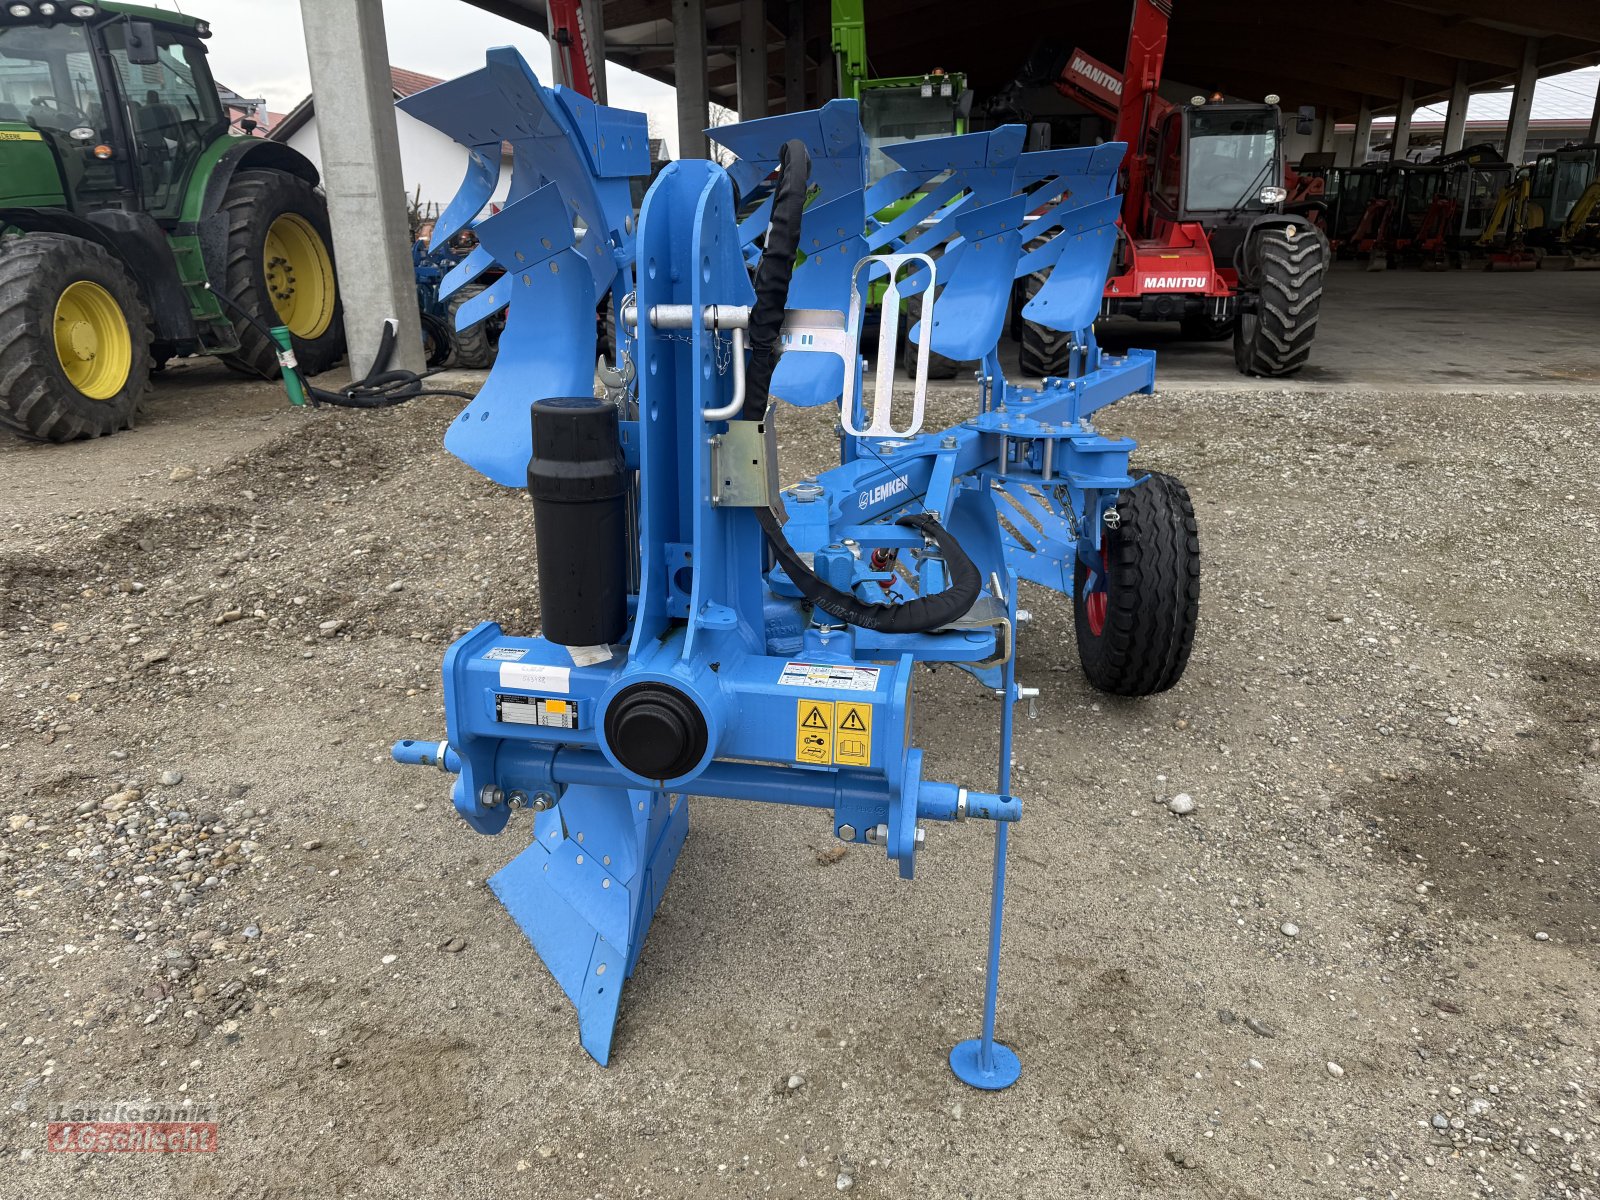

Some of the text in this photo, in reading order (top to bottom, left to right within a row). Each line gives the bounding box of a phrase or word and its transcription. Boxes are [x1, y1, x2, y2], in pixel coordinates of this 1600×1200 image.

[1071, 56, 1123, 96] MANITOU
[1144, 277, 1206, 289] MANITOU
[869, 474, 909, 505] LEMKEN
